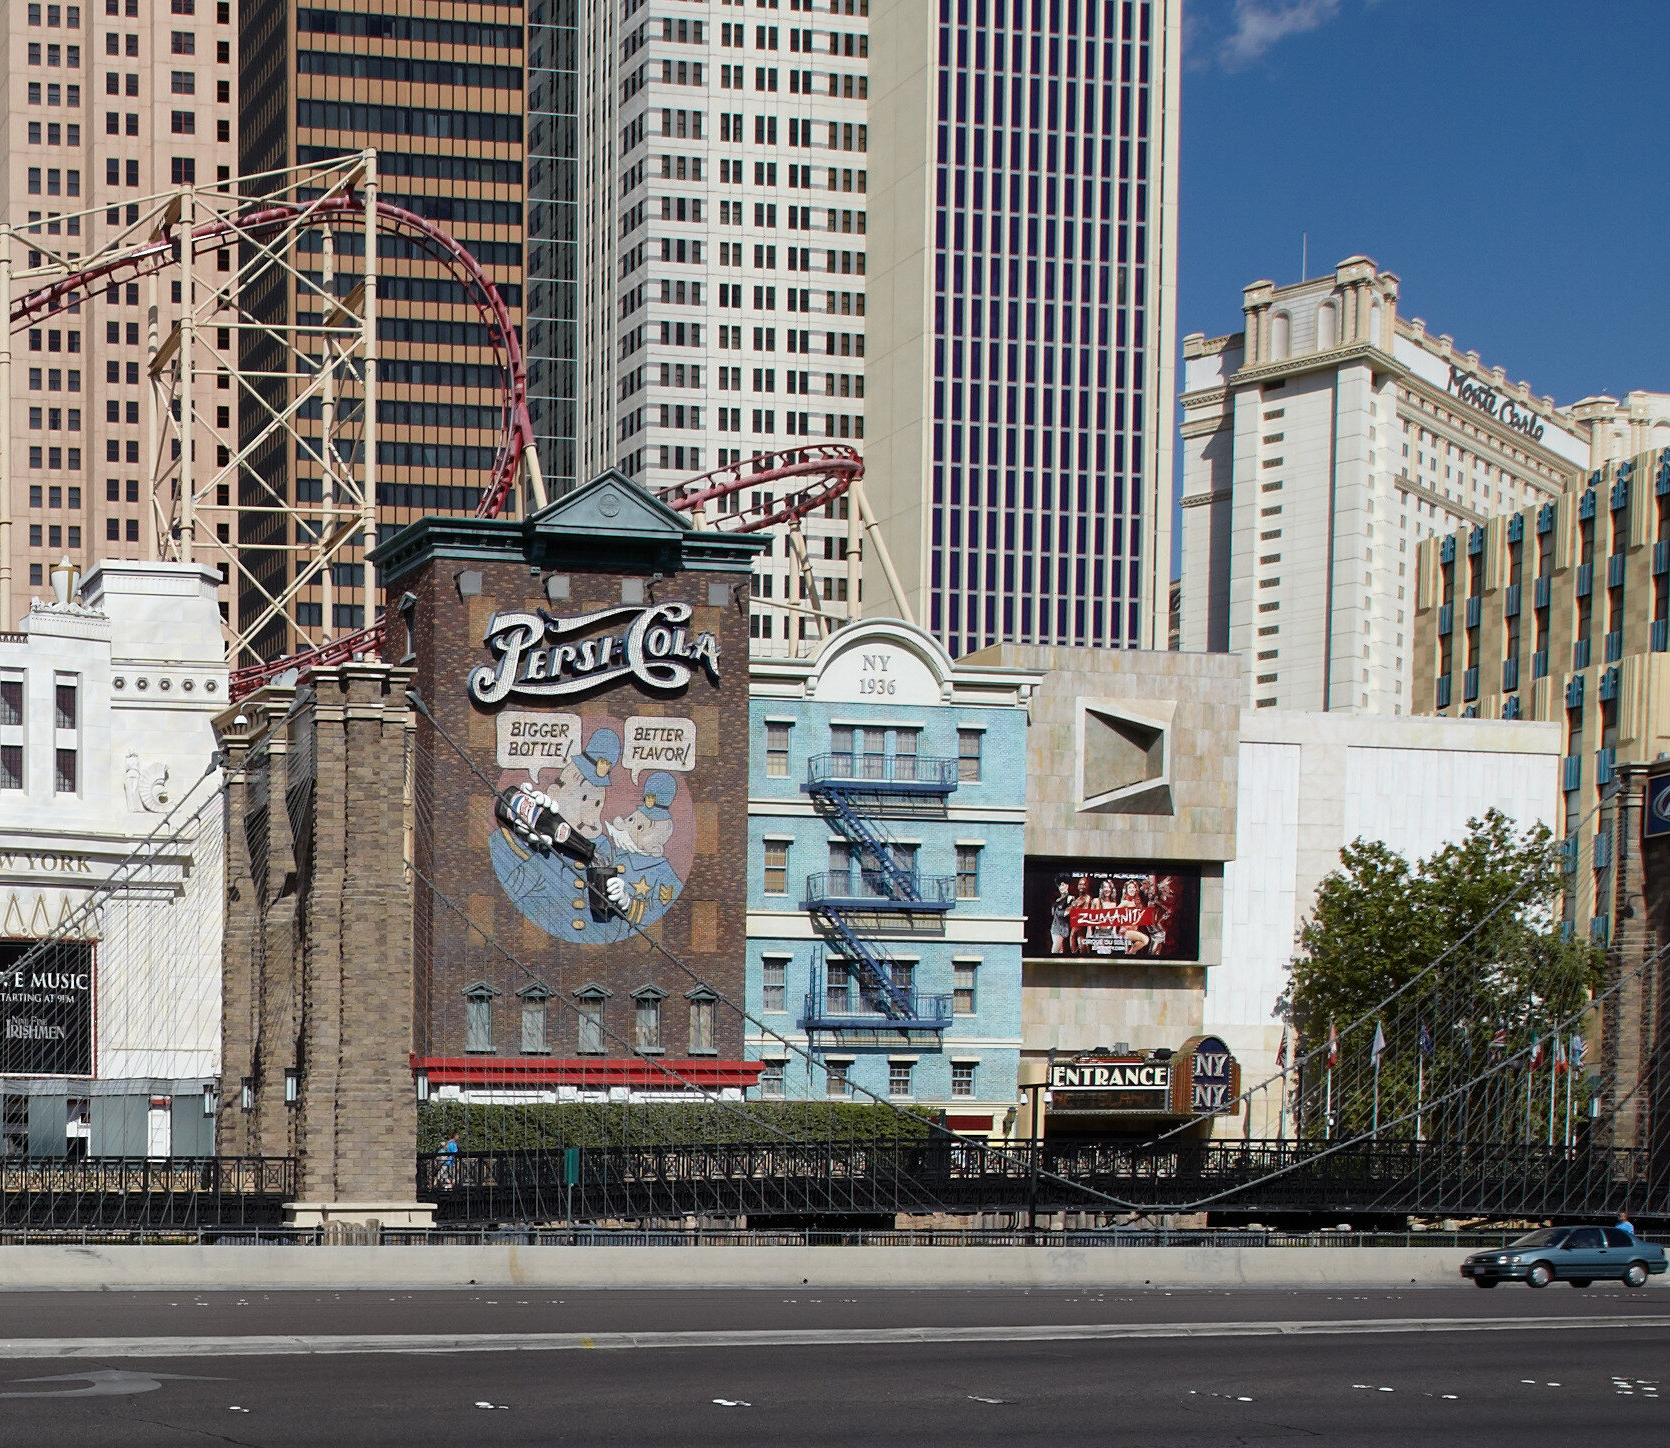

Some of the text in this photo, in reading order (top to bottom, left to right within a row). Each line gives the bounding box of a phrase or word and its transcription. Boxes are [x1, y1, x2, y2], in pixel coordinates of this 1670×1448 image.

[1447, 364, 1544, 443] Monte Carlo
[862, 654, 891, 672] NY
[859, 678, 896, 695] 1936
[510, 721, 570, 739] BIGGER
[633, 727, 684, 742] BETTER
[508, 740, 574, 764] BOTTLE!
[632, 743, 691, 766] FLAVOR!
[25, 853, 93, 873] YORK
[1077, 907, 1146, 925] ZUMANITY
[30, 972, 88, 990] MUSIC
[44, 993, 55, 1003] AT
[1192, 1053, 1228, 1077] NY
[1052, 1066, 1167, 1087] ENTRANCE
[1192, 1083, 1228, 1107] NY
